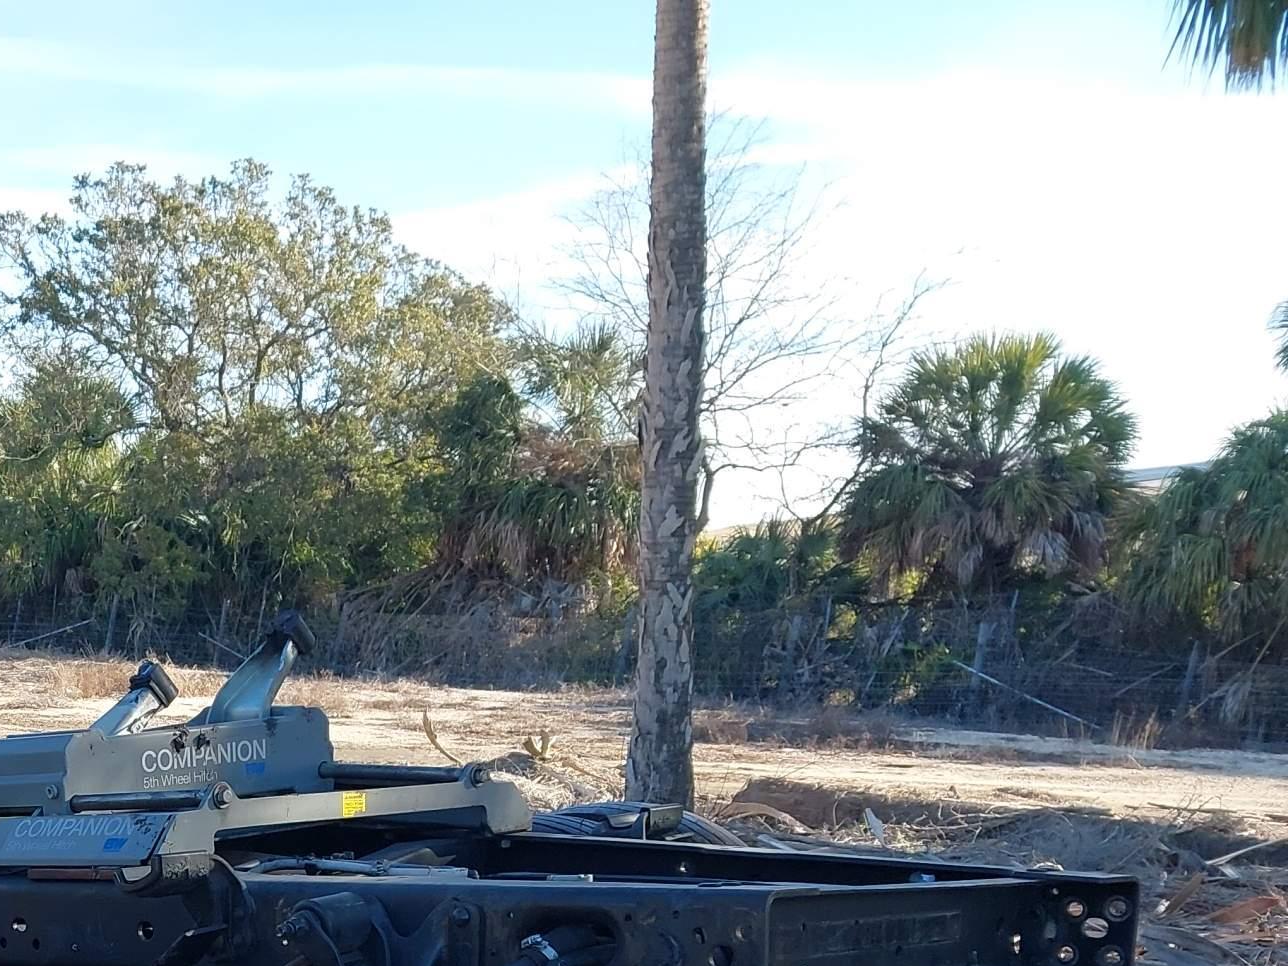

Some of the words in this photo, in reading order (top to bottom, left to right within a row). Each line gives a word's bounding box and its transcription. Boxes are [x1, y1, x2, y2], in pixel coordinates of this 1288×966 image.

[141, 739, 267, 773] COMPANION
[143, 776, 159, 789] 5th
[161, 772, 191, 787] Wheel
[14, 816, 135, 838] COMPANION
